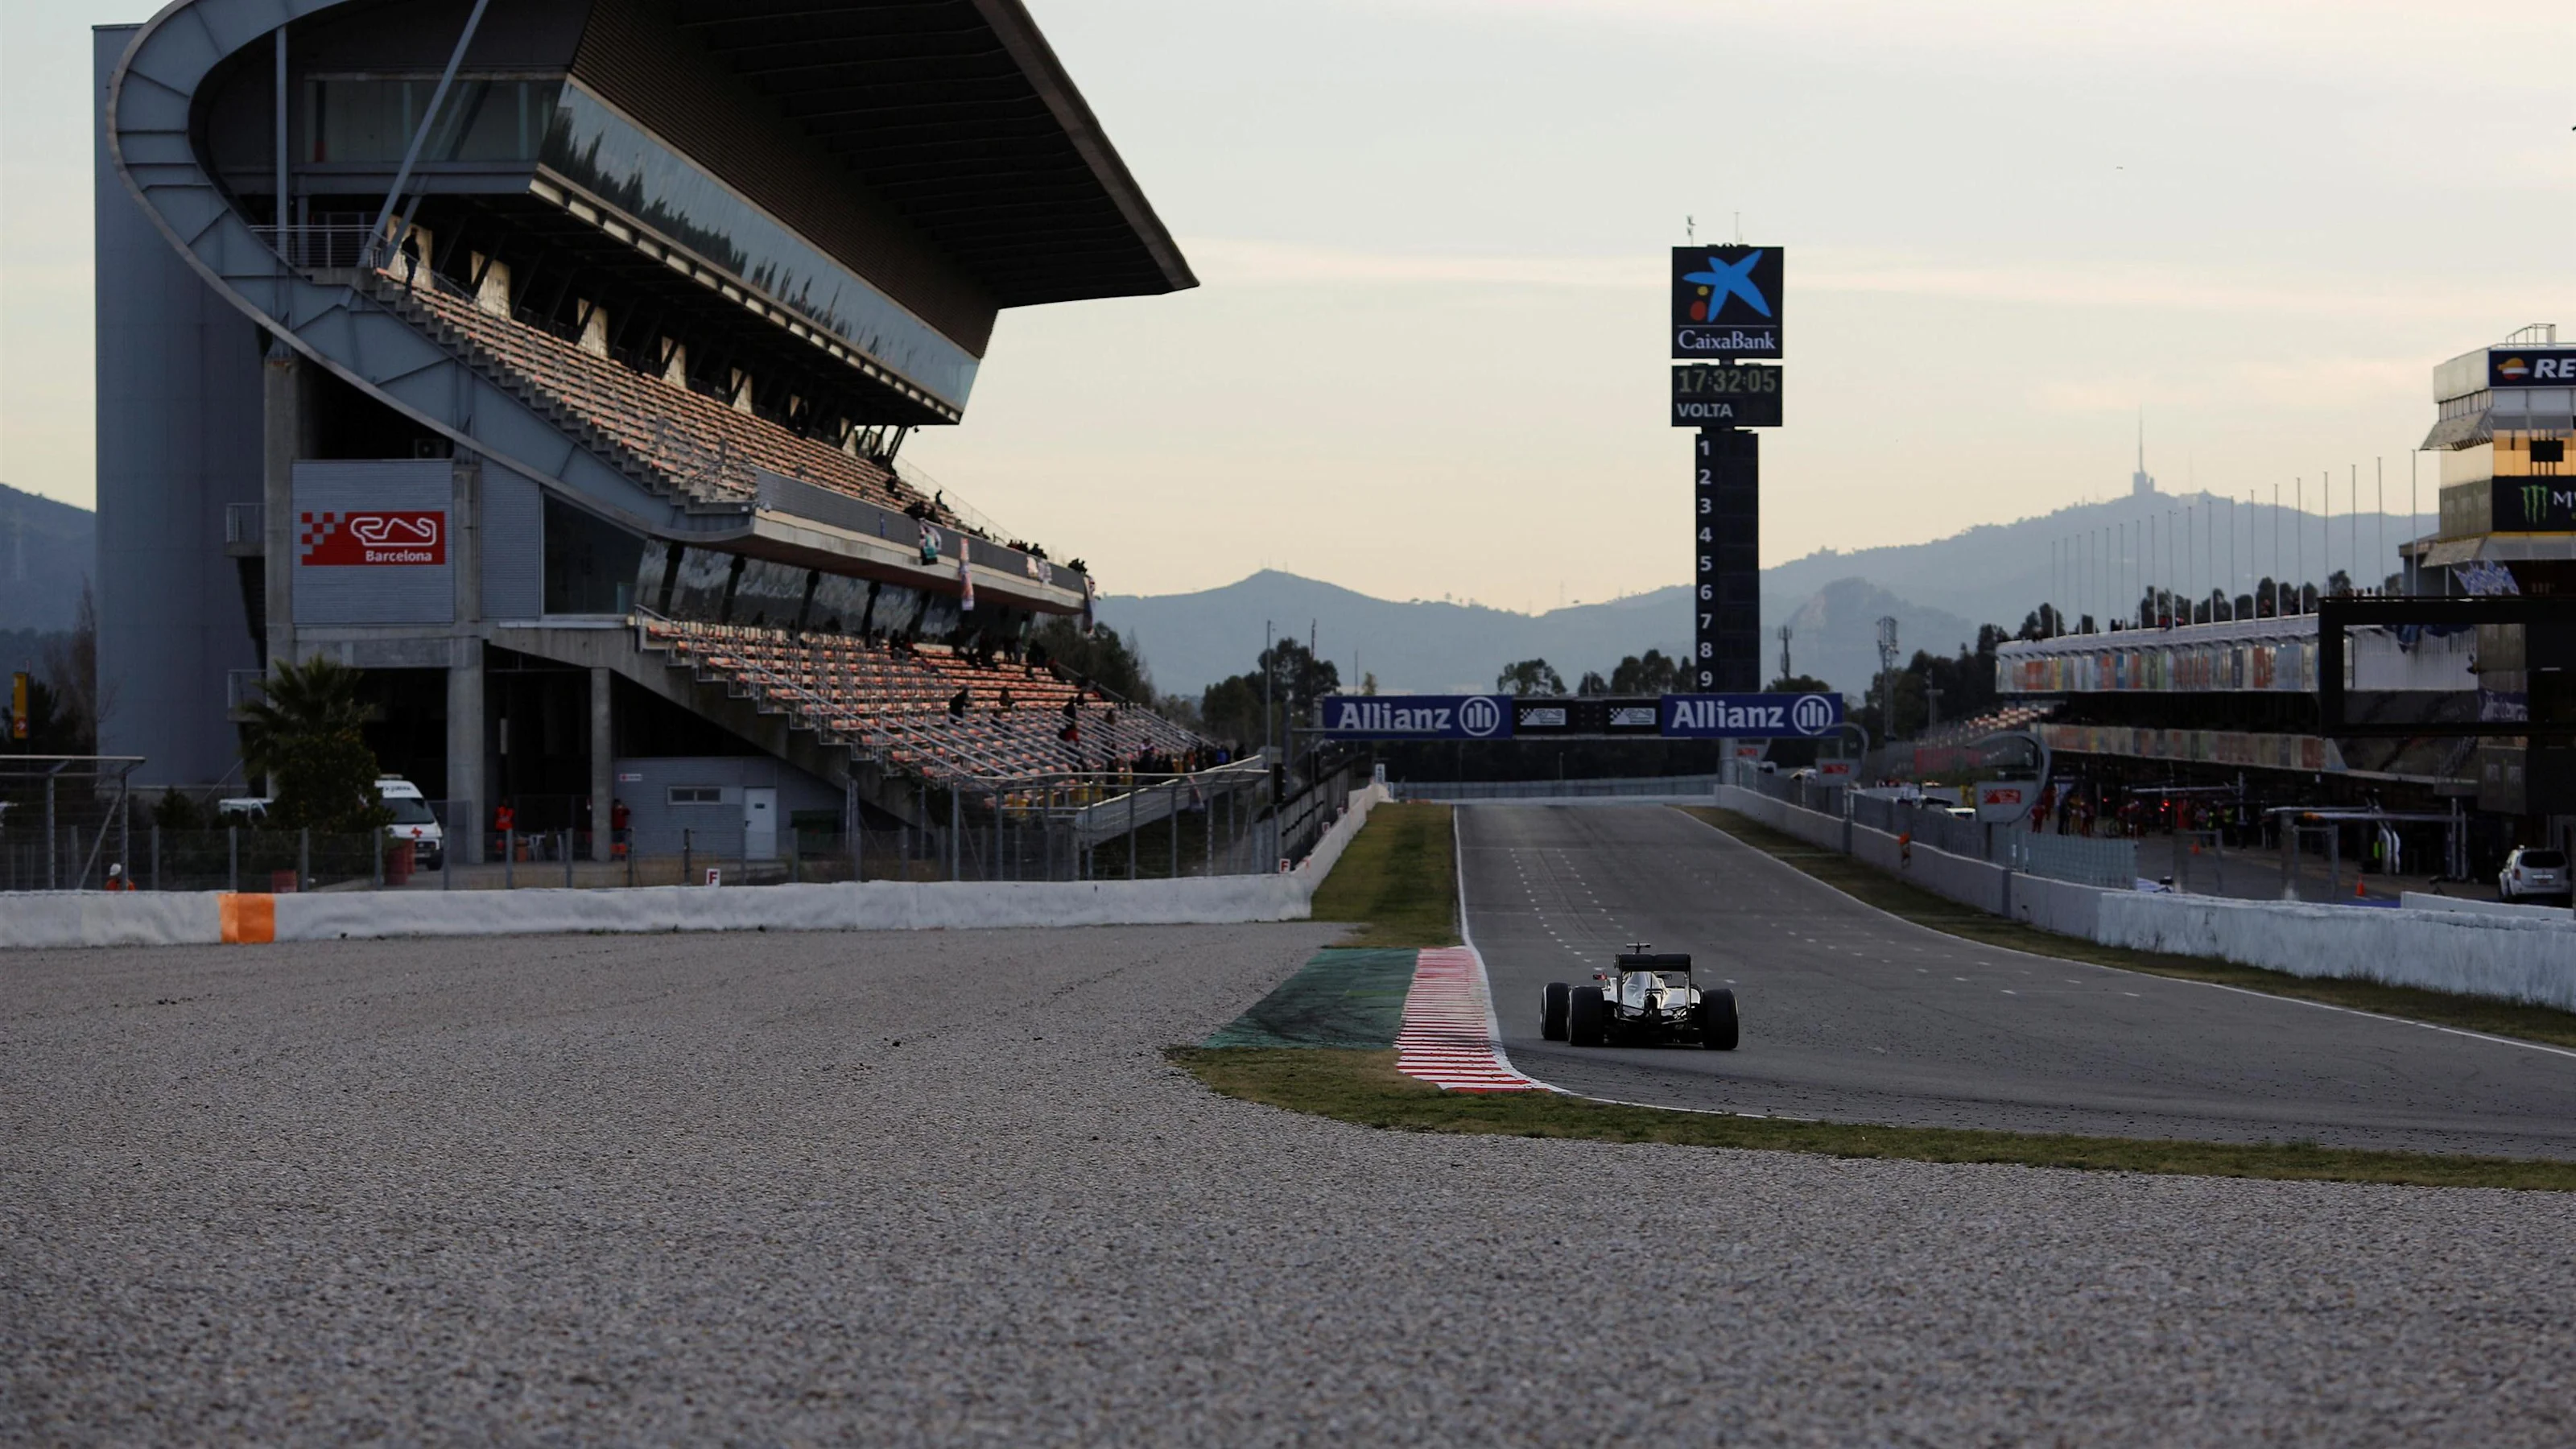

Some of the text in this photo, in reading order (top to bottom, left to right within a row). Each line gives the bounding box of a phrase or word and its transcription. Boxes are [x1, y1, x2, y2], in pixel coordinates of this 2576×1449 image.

[1678, 329, 1776, 349] CaixaBank
[2534, 358, 2576, 378] RE
[1678, 369, 1777, 393] 17:32:05
[1677, 402, 1733, 418] VOLTA
[1700, 440, 1709, 456] 1
[1699, 469, 1711, 485] 2
[1700, 498, 1711, 514] 3
[2553, 490, 2576, 509] M
[1699, 527, 1712, 543] 4
[365, 549, 432, 562] Barcelona
[1700, 556, 1711, 572] 5
[1700, 584, 1712, 601] 6
[1700, 613, 1712, 629] 7
[1700, 642, 1712, 658] 8
[1700, 671, 1713, 687] 9
[1338, 702, 1451, 729] Allianz
[1671, 700, 1785, 729] Allianz
[1281, 861, 1289, 872] F
[709, 871, 717, 884] F
